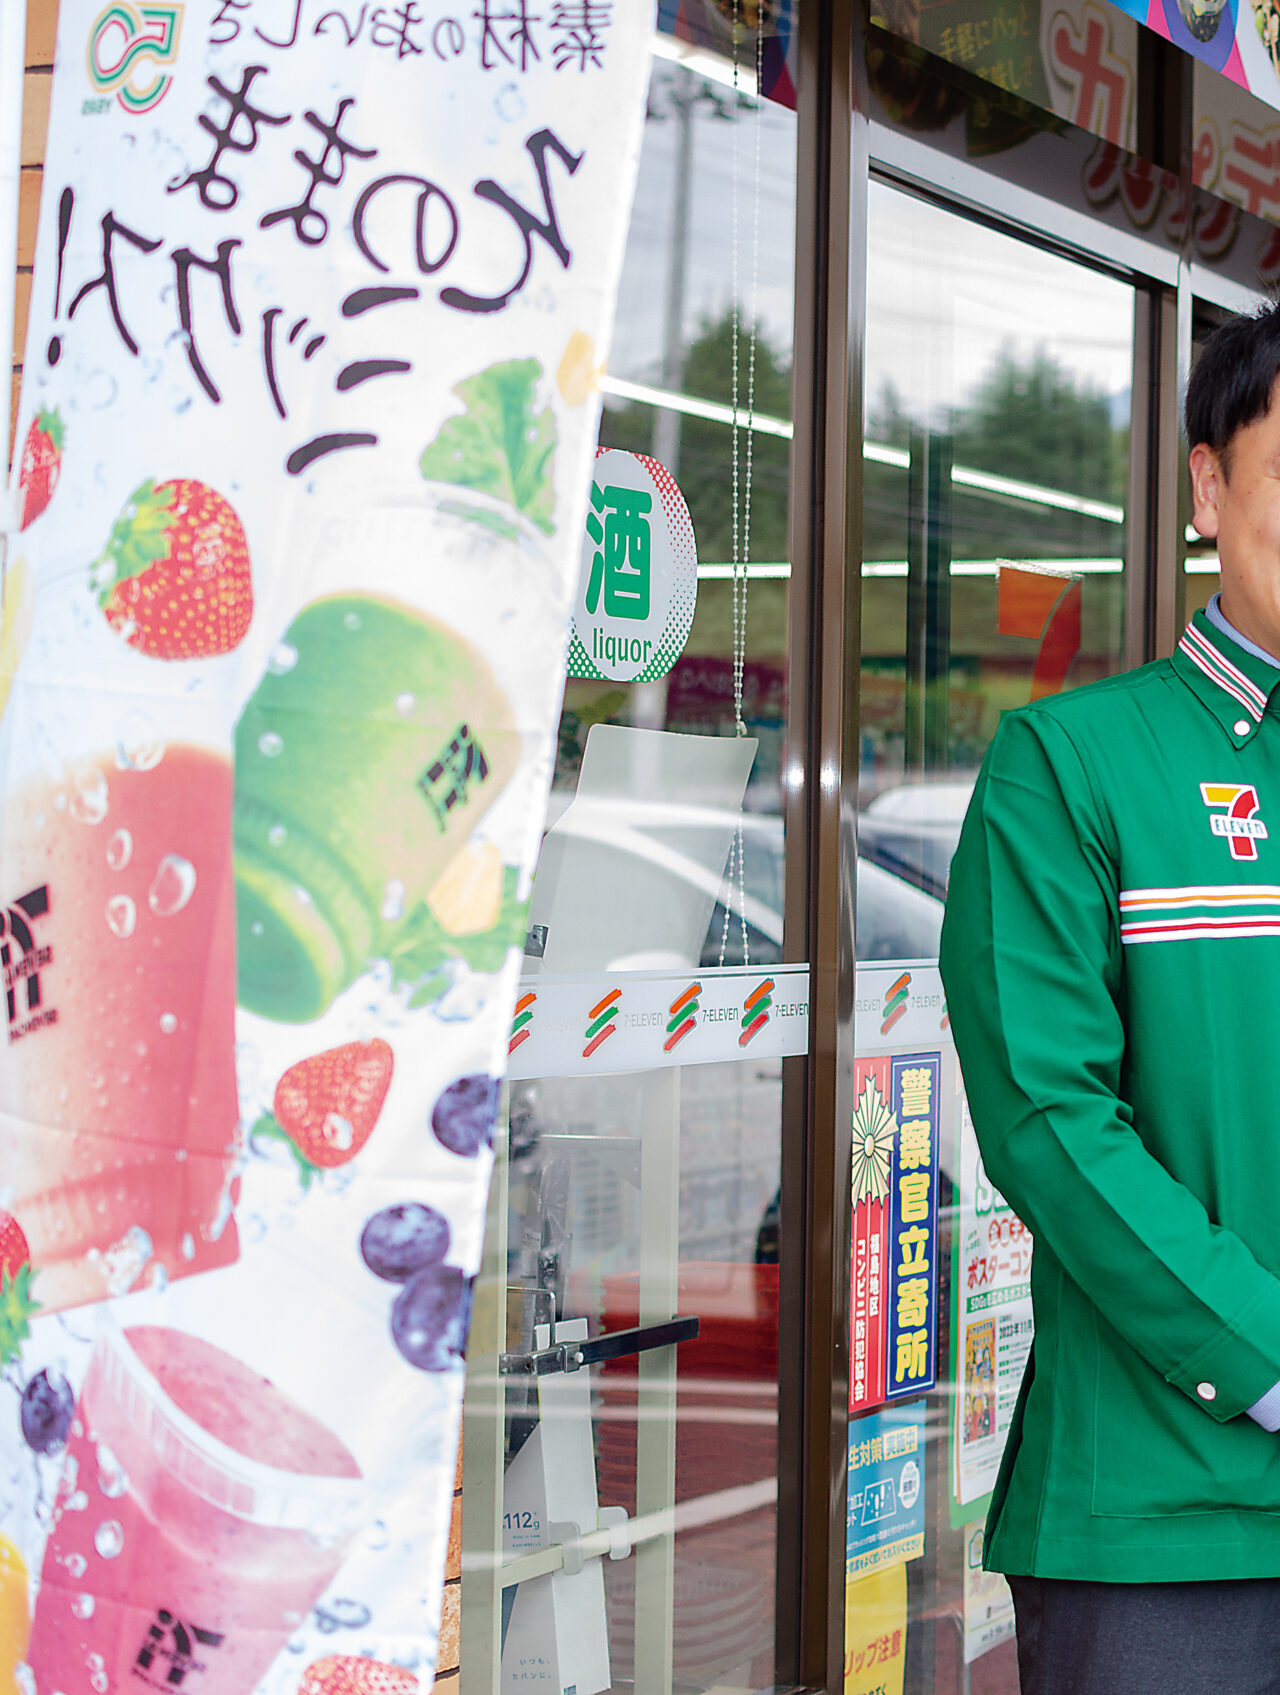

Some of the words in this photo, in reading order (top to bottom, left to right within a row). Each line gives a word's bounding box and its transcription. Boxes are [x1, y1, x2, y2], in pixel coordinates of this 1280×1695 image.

[585, 480, 653, 620] 酒
[592, 627, 653, 667] liquor
[869, 1233, 880, 1317] 福島地区
[895, 1067, 932, 1383] 警察官立寄所
[854, 1239, 866, 1402] コンビニ防犯協会
